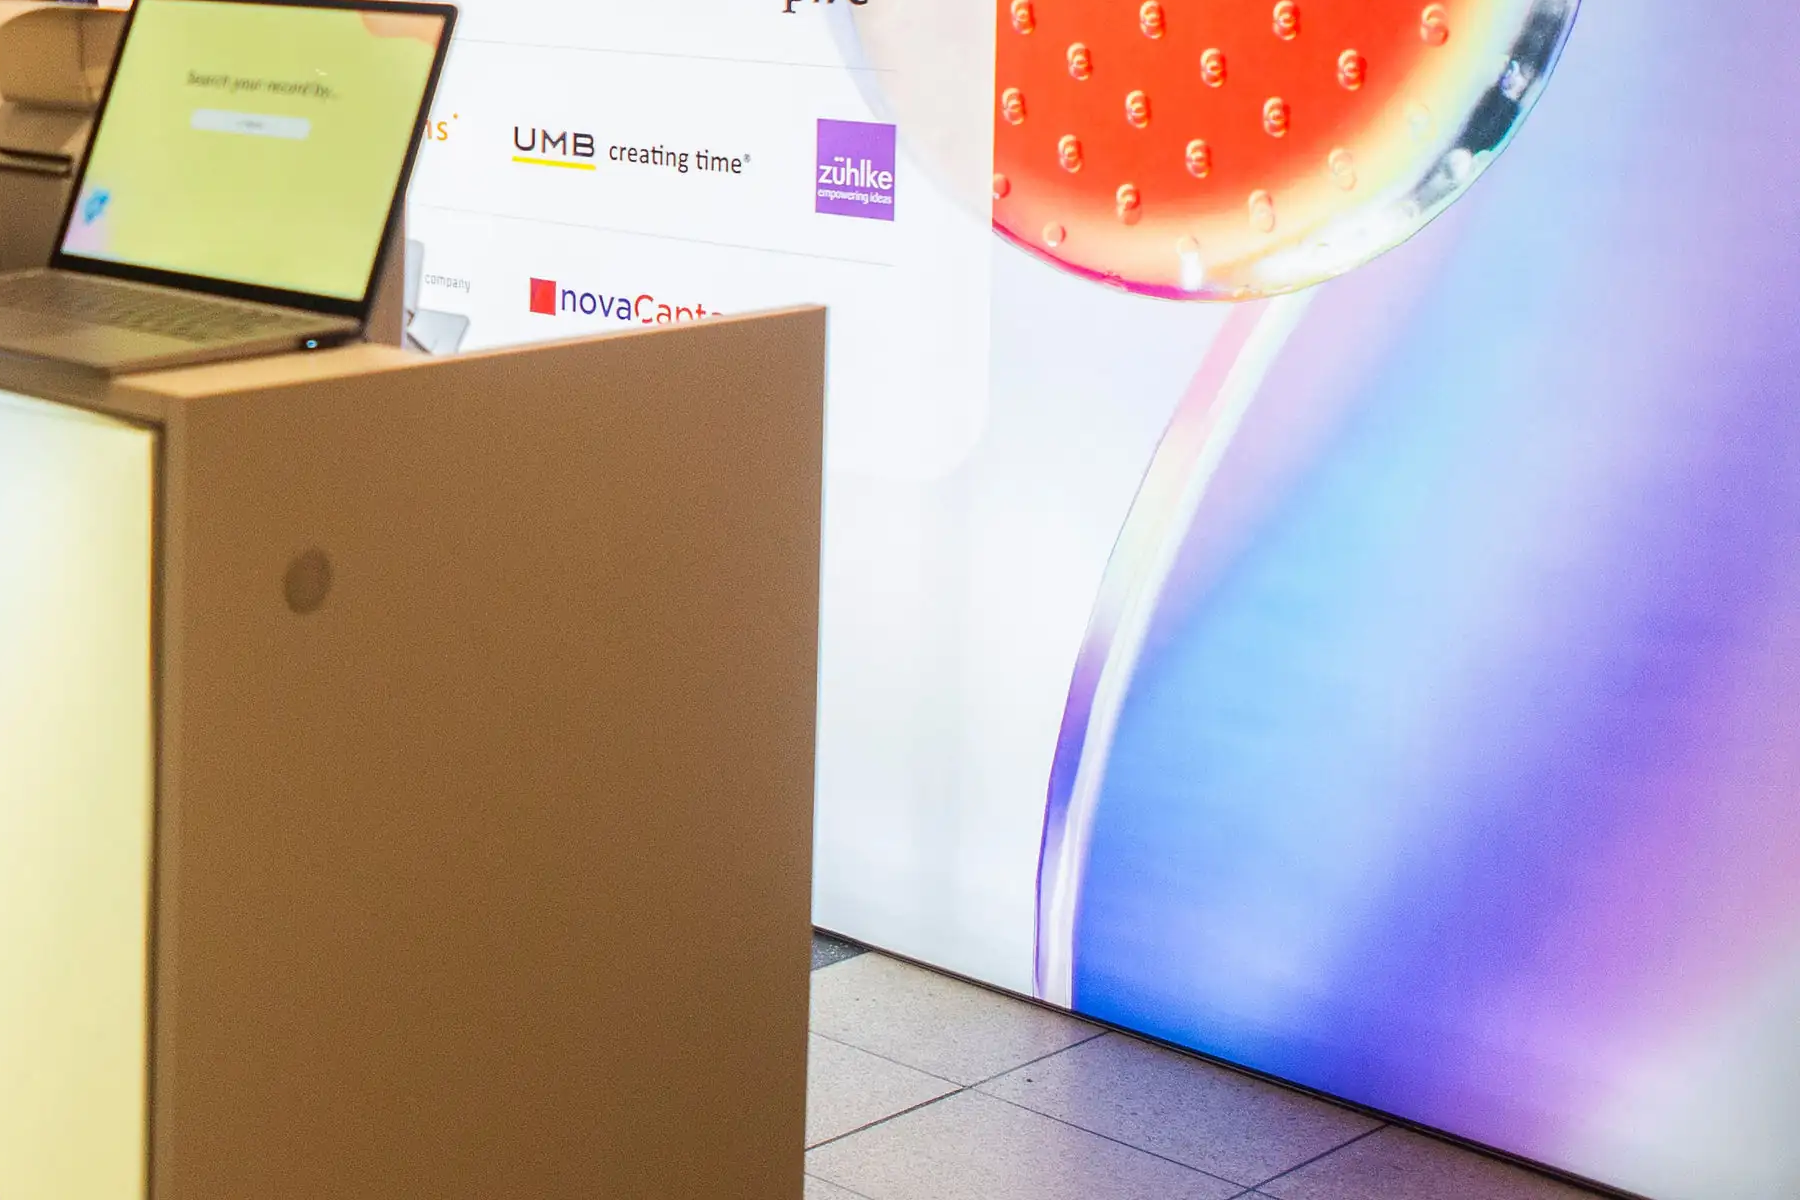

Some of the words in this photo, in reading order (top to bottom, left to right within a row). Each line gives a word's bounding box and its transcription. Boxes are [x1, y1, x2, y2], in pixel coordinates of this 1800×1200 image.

[513, 126, 595, 158] UMB
[610, 145, 688, 173] creating
[817, 157, 892, 190] zühlke
[817, 189, 869, 204] empowering
[870, 192, 892, 204] ideas
[424, 274, 471, 293] company
[561, 288, 723, 324] novaCat
